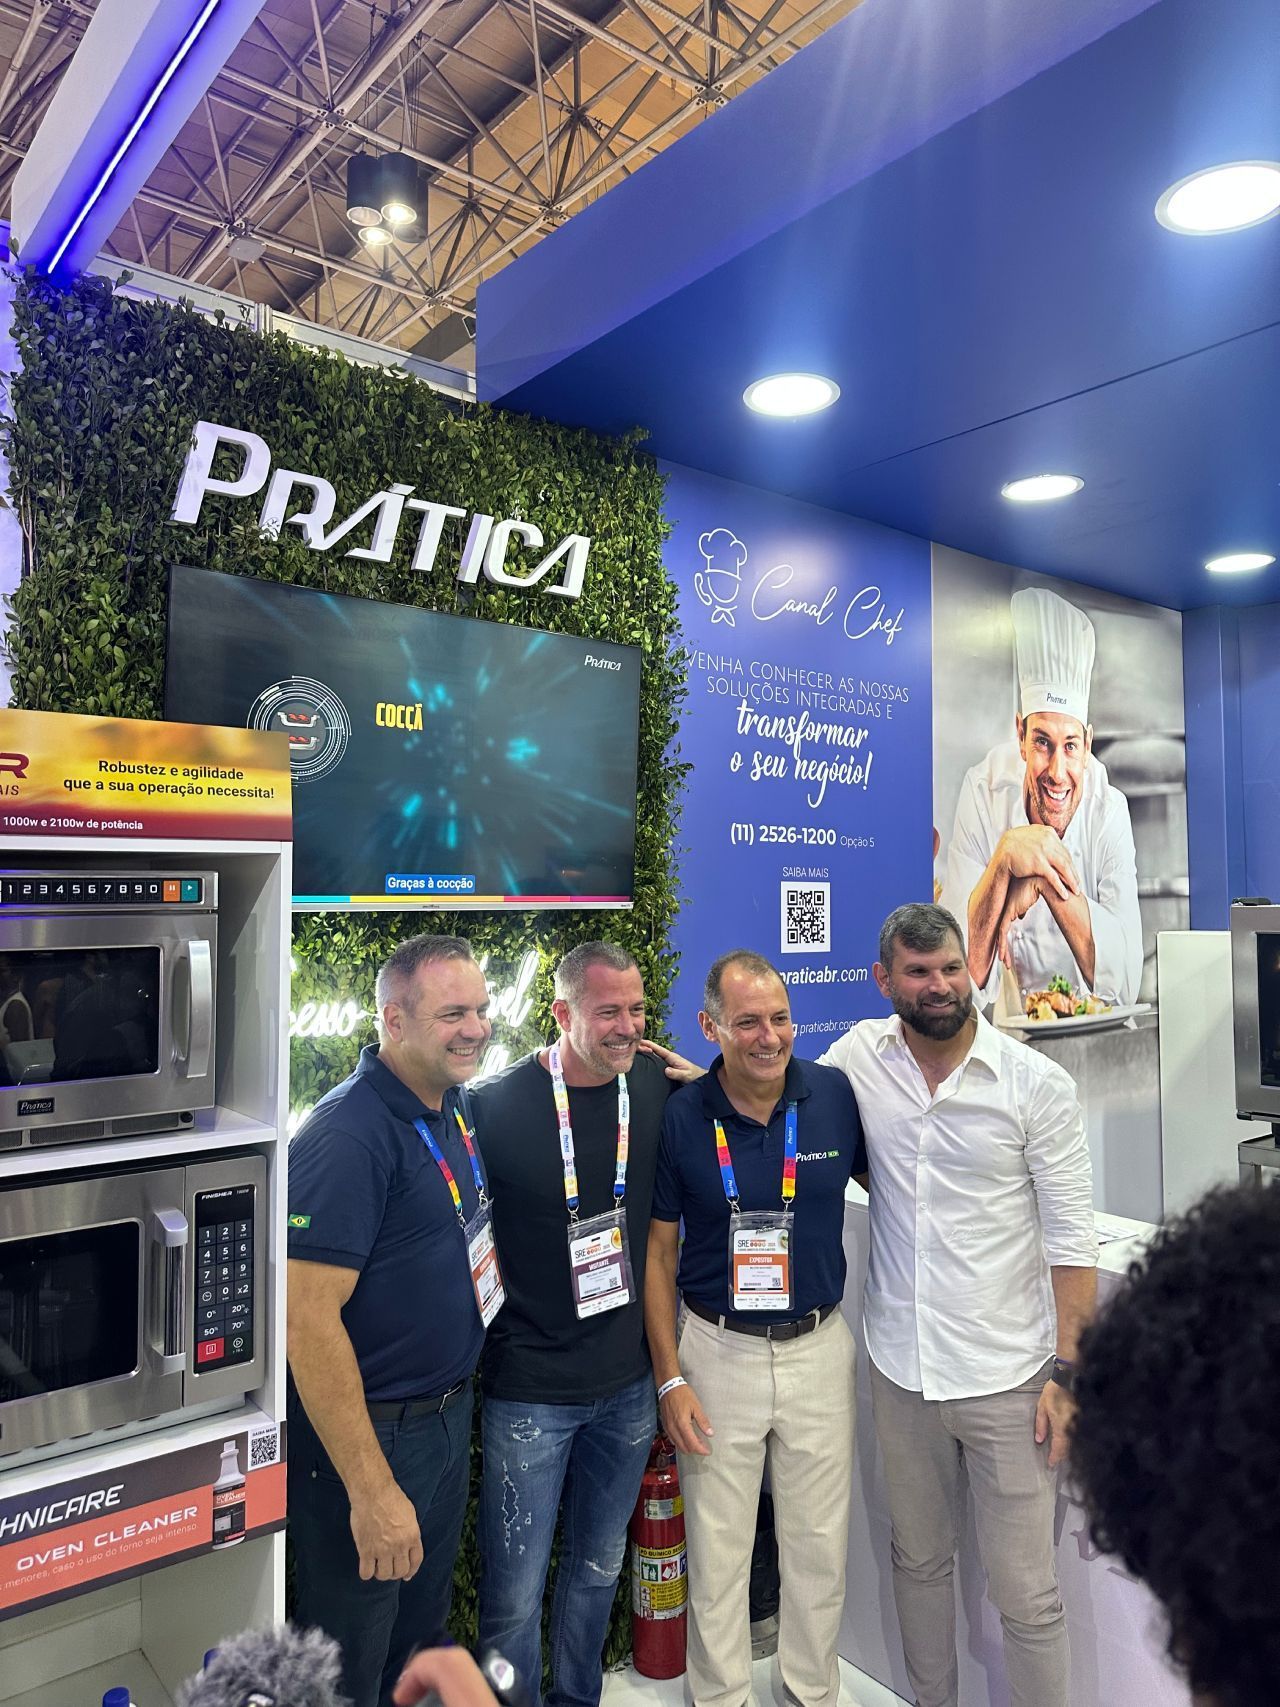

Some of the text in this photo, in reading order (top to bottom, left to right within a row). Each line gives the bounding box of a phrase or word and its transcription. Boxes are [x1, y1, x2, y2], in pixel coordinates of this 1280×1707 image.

[169, 420, 591, 599] PRÁTICA
[751, 564, 905, 645] Canal Chef
[684, 647, 909, 703] VENHA CONHECER AS NOSSAS
[706, 676, 893, 720] SOLUÇÕES INTEGRADAS E
[736, 698, 869, 759] transformar
[98, 760, 244, 780] Robustez e agilidade
[730, 750, 874, 808] o seu negócio!
[63, 779, 274, 799] que a sua operação necessita!
[3, 816, 143, 831] 1000w e 2100w de potência
[730, 822, 875, 848] (11) 2526-1200 Opção 5
[782, 866, 829, 878] SAIBA MAIS
[8, 884, 158, 894] 1 2 3 4 5 6 7 8 9 0
[387, 876, 474, 891] Graças à cocção
[201, 1190, 233, 1200] FINISHER
[205, 1224, 247, 1238] 1 2 3
[204, 1244, 246, 1258] 4 5 6
[204, 1264, 246, 1279] 7 8 9
[222, 1286, 229, 1295] 0
[17, 1505, 199, 1571] OVEN CLEANER
[5, 1570, 50, 1589] menores,
[52, 1562, 75, 1574] caso
[86, 1552, 103, 1564] uso
[119, 1541, 143, 1554] forno
[145, 1533, 164, 1545] seja
[165, 1523, 198, 1539] intenso
